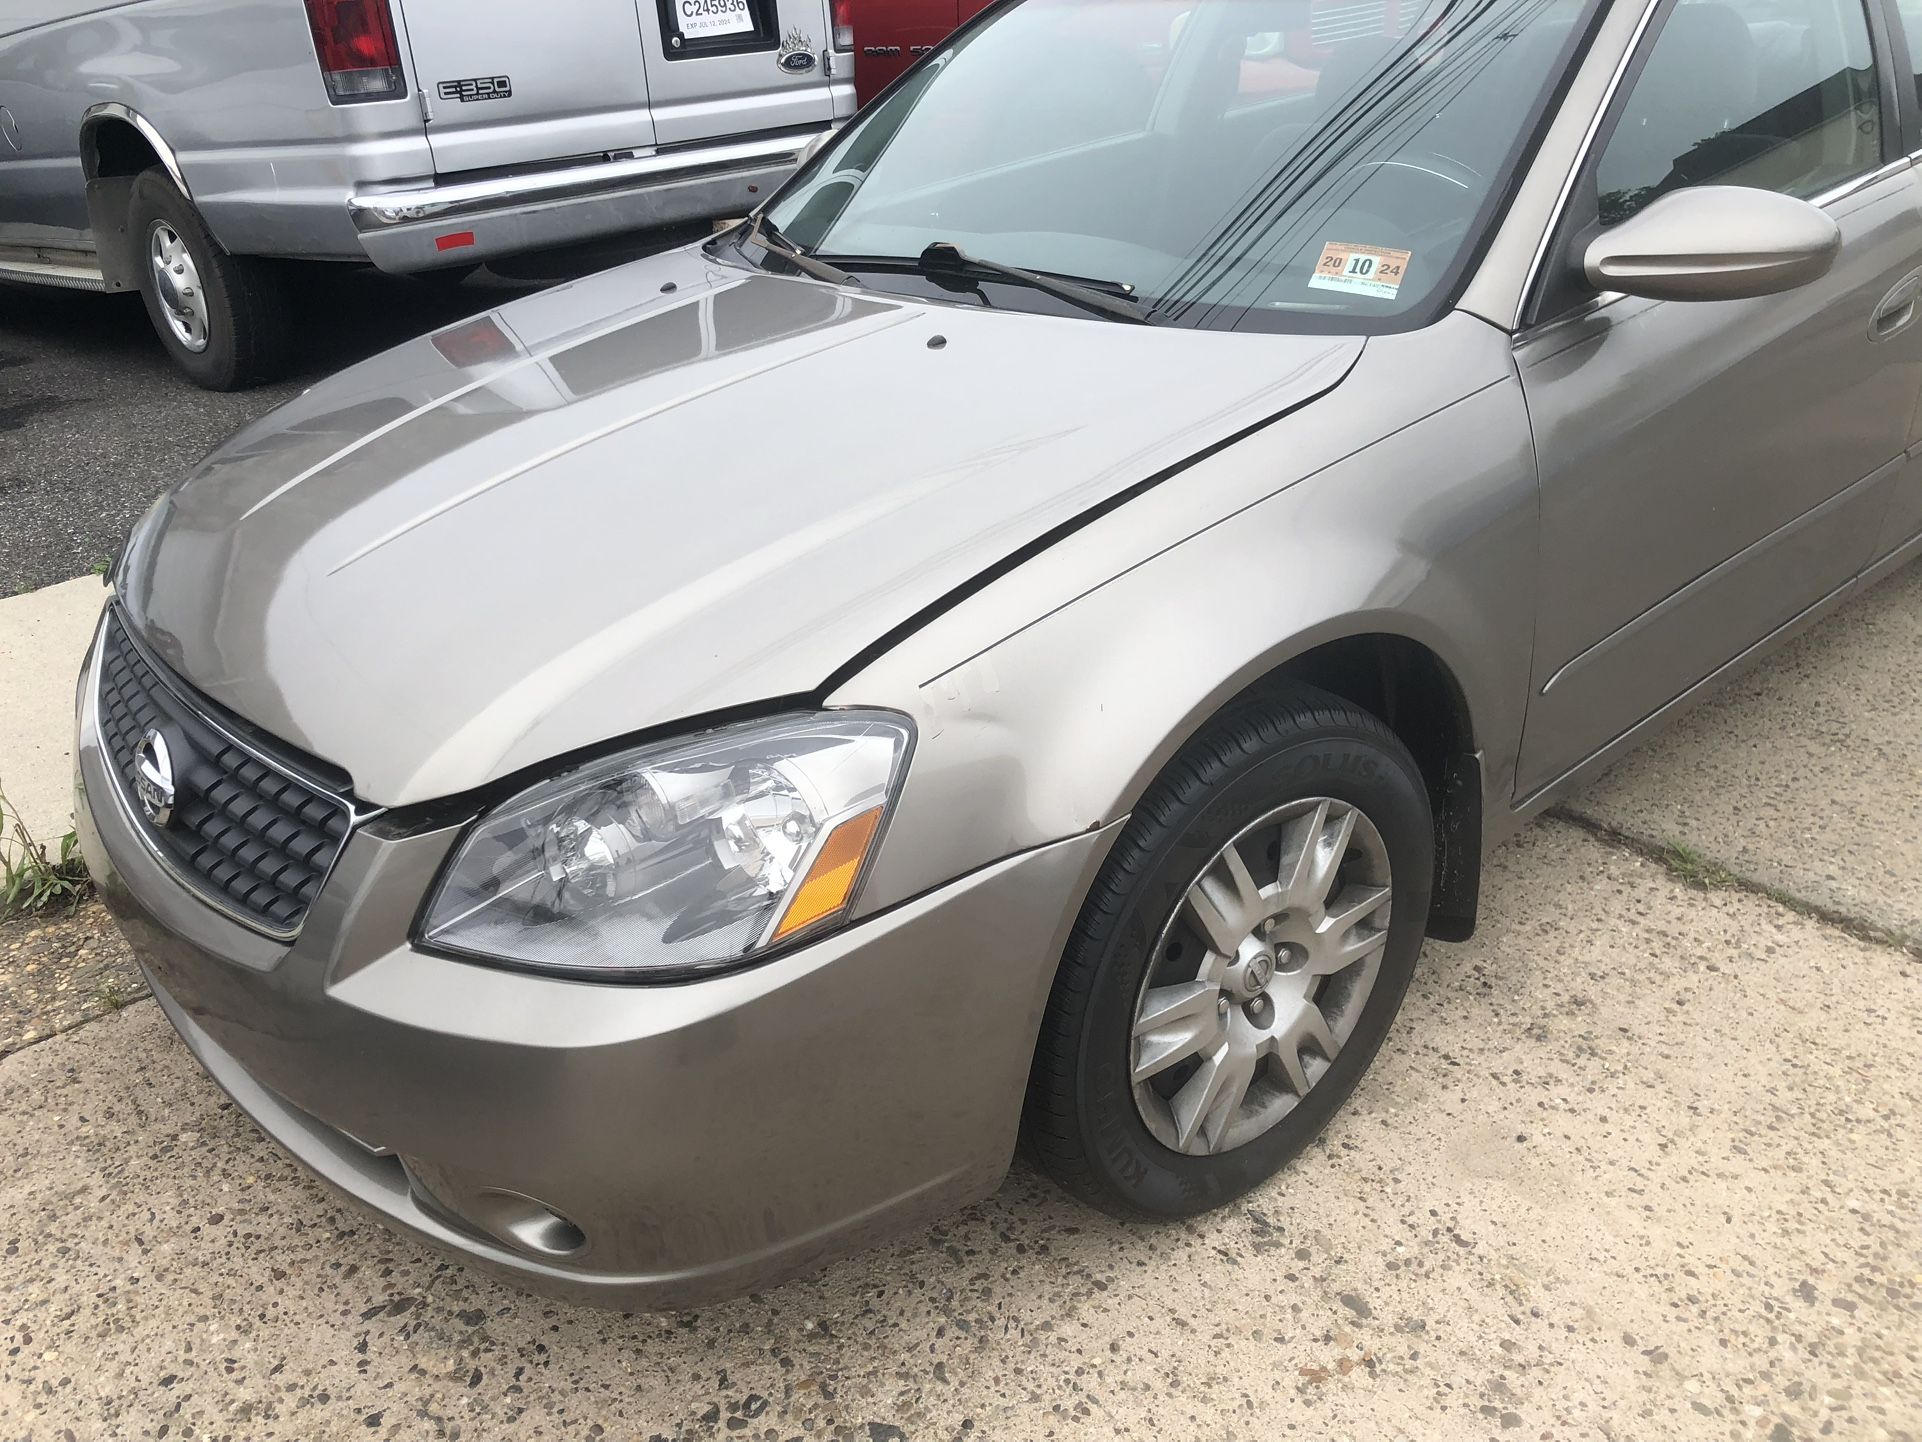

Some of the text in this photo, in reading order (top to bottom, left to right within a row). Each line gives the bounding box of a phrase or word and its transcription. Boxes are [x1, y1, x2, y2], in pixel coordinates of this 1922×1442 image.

[682, 0, 745, 17] C245936
[718, 18, 731, 26] 2024
[790, 55, 807, 66] Ford
[463, 94, 489, 102] SUPER
[1323, 256, 1400, 276] 20 10 24
